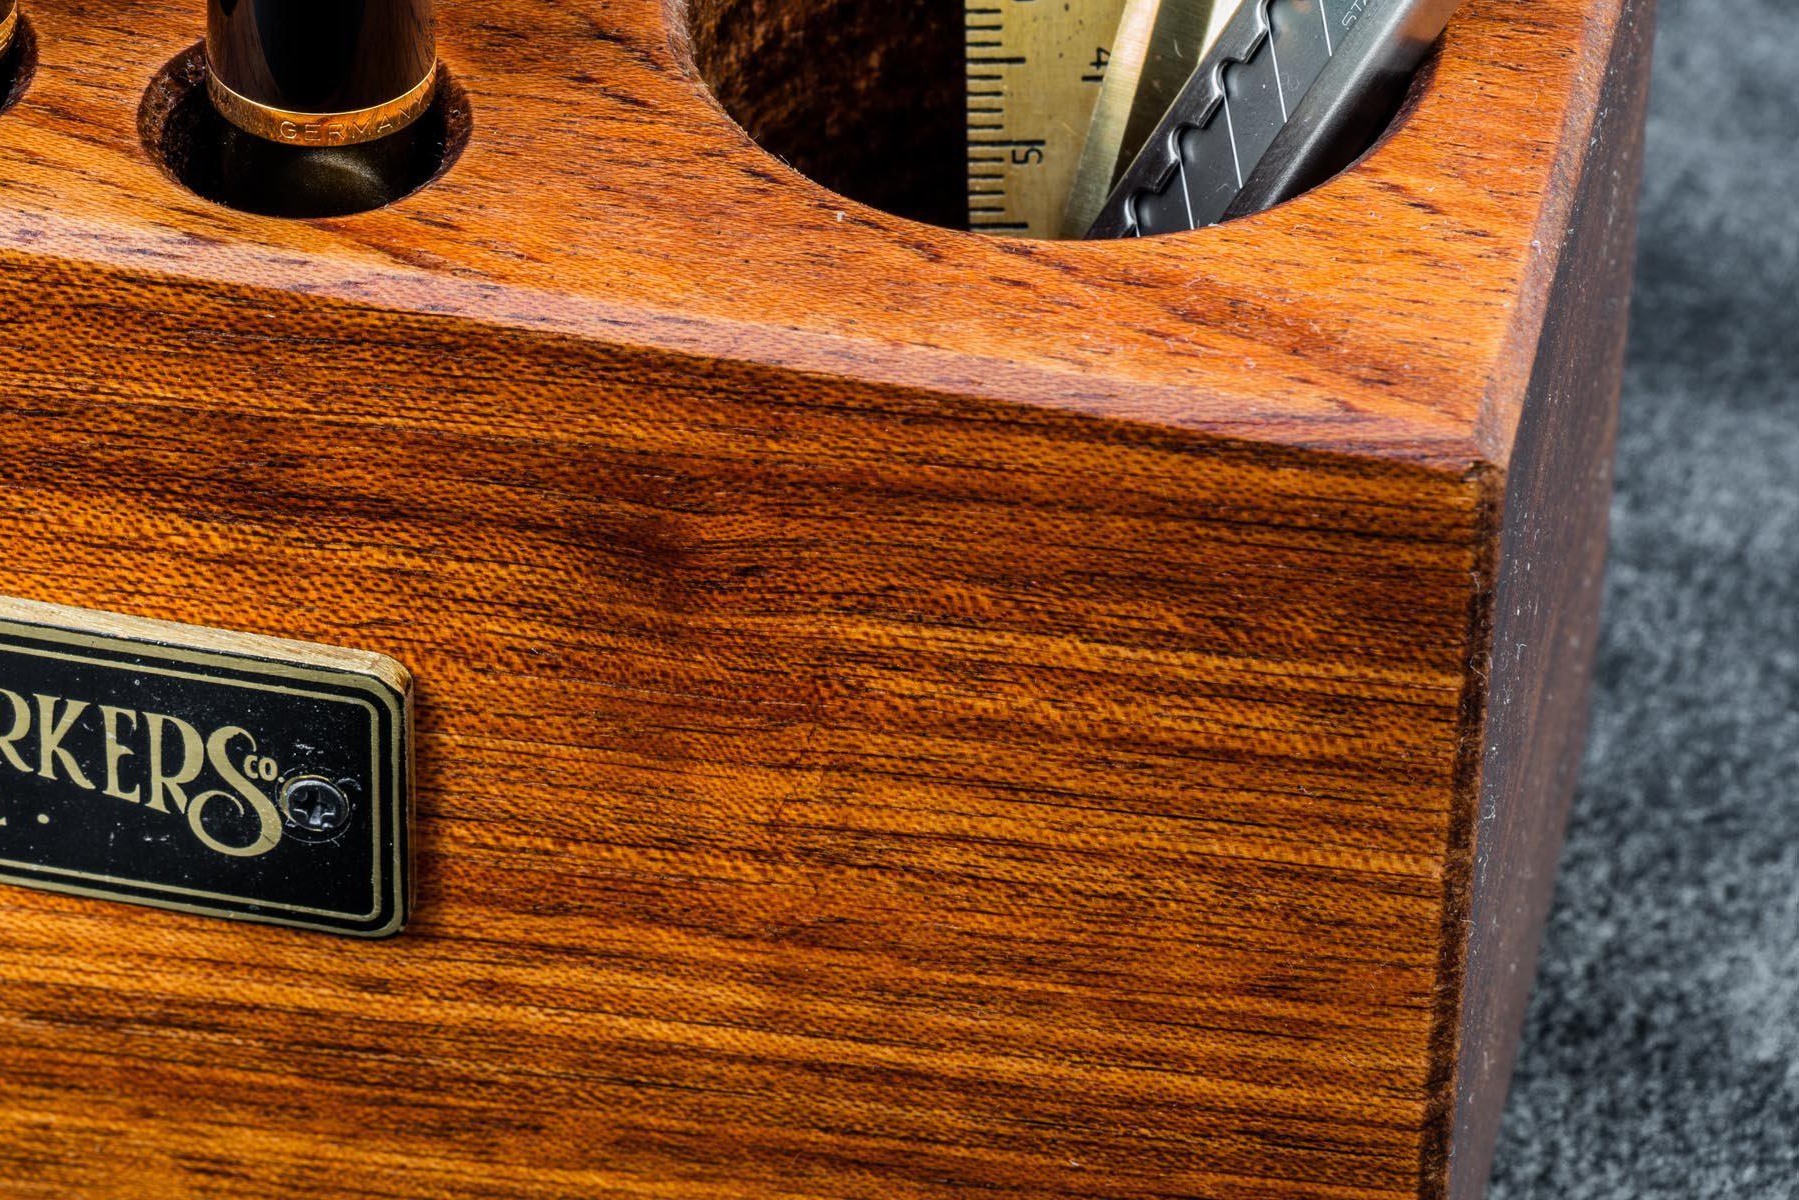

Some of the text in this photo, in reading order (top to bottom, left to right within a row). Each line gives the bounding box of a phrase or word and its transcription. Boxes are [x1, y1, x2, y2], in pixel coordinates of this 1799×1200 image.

[1089, 46, 1112, 70] 4
[278, 85, 427, 141] GERMANY
[1012, 146, 1044, 165] 5
